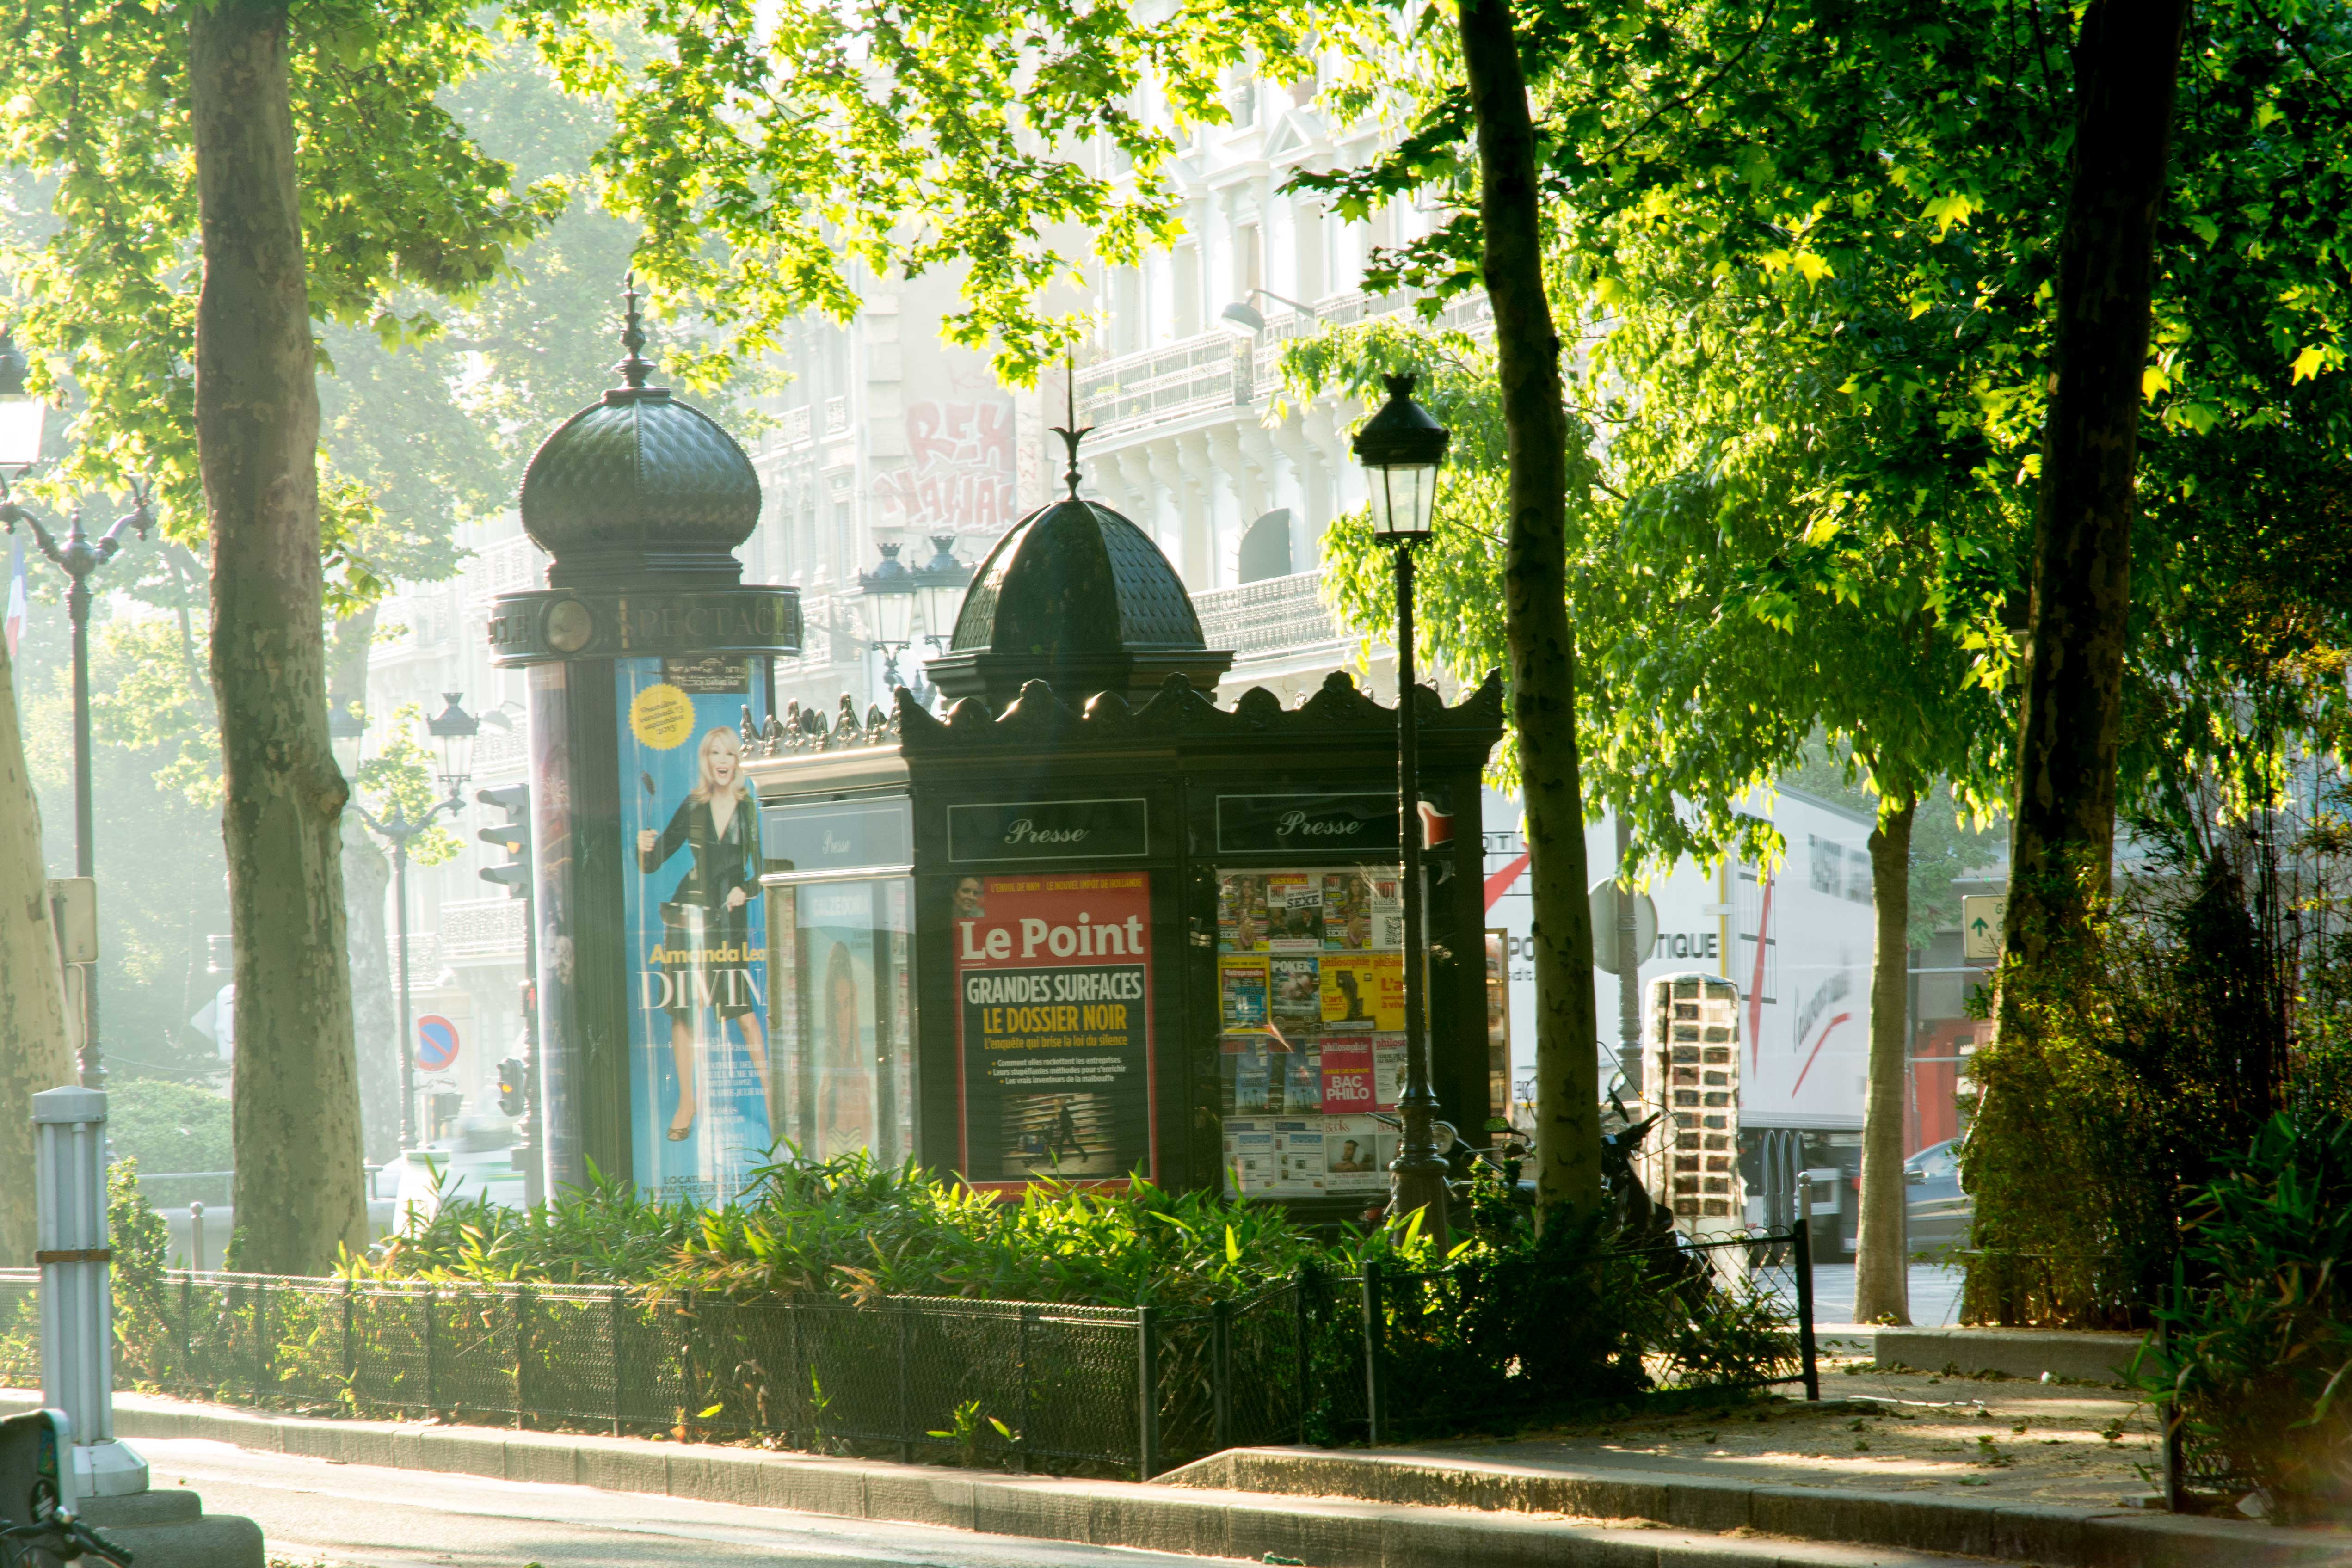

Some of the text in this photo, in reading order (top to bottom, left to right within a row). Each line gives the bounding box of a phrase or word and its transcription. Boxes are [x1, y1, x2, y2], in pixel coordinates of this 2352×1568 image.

[1276, 810, 1365, 835] Presse
[1004, 818, 1090, 844] Presse
[822, 830, 851, 855] Presse
[1047, 881, 1054, 891] LE
[1055, 880, 1078, 890] NOUVEL
[1100, 879, 1109, 888] DE
[1109, 878, 1142, 888] HOLLANDE
[1286, 894, 1319, 907] SEXE
[959, 912, 1145, 960] Le Point
[649, 941, 766, 964] Amanda Lea
[1271, 961, 1311, 972] POKER
[1320, 957, 1370, 969] philosophie
[637, 969, 768, 1009] DIVIN
[967, 972, 1142, 1004] GRANDES SURFACES
[1381, 978, 1404, 991] L'a
[983, 1004, 1127, 1033] LE DOSSIER NOIR
[984, 1034, 1128, 1050] L'enquête qui brise la loi du silence
[1322, 1041, 1368, 1053] philosophie
[1376, 1038, 1406, 1050] philoso
[1086, 1057, 1121, 1065] entreprises
[1011, 1067, 1048, 1076] stupéfiantes
[1081, 1067, 1096, 1075] pour
[1331, 1075, 1362, 1088] BAC
[1326, 1087, 1370, 1101] PHILO
[1325, 1119, 1350, 1132] Books
